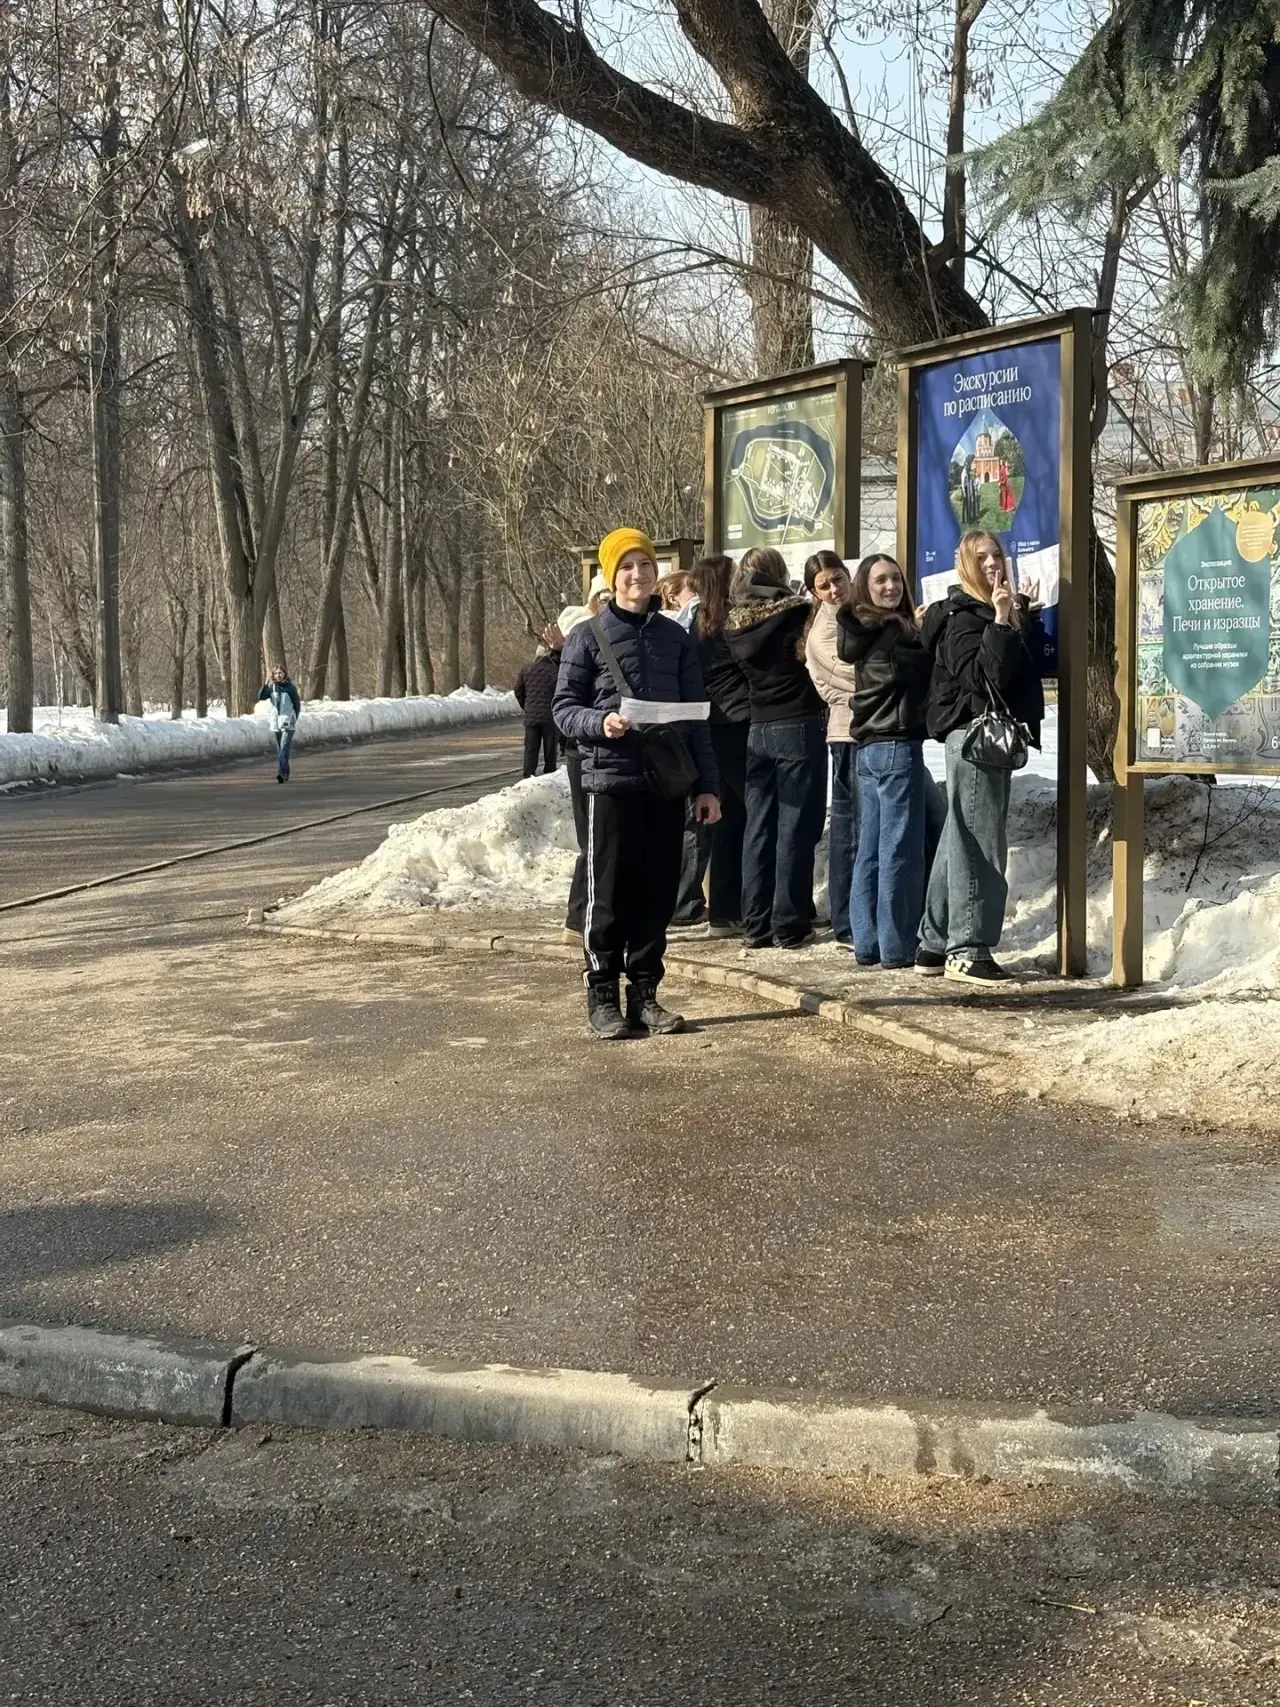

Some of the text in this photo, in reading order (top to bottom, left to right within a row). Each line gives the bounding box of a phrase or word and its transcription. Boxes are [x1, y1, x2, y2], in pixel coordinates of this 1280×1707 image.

[953, 366, 1019, 393] Экскурсии
[943, 386, 1032, 418] по расписанию
[1200, 559, 1232, 568] Экспозиция
[1187, 574, 1246, 593] Открытое
[1188, 596, 1245, 615] хранение.
[1172, 615, 1261, 632] Печи и изразцы
[1043, 643, 1056, 656] 6+
[1214, 642, 1237, 650] образцы
[1271, 735, 1280, 749] 6
